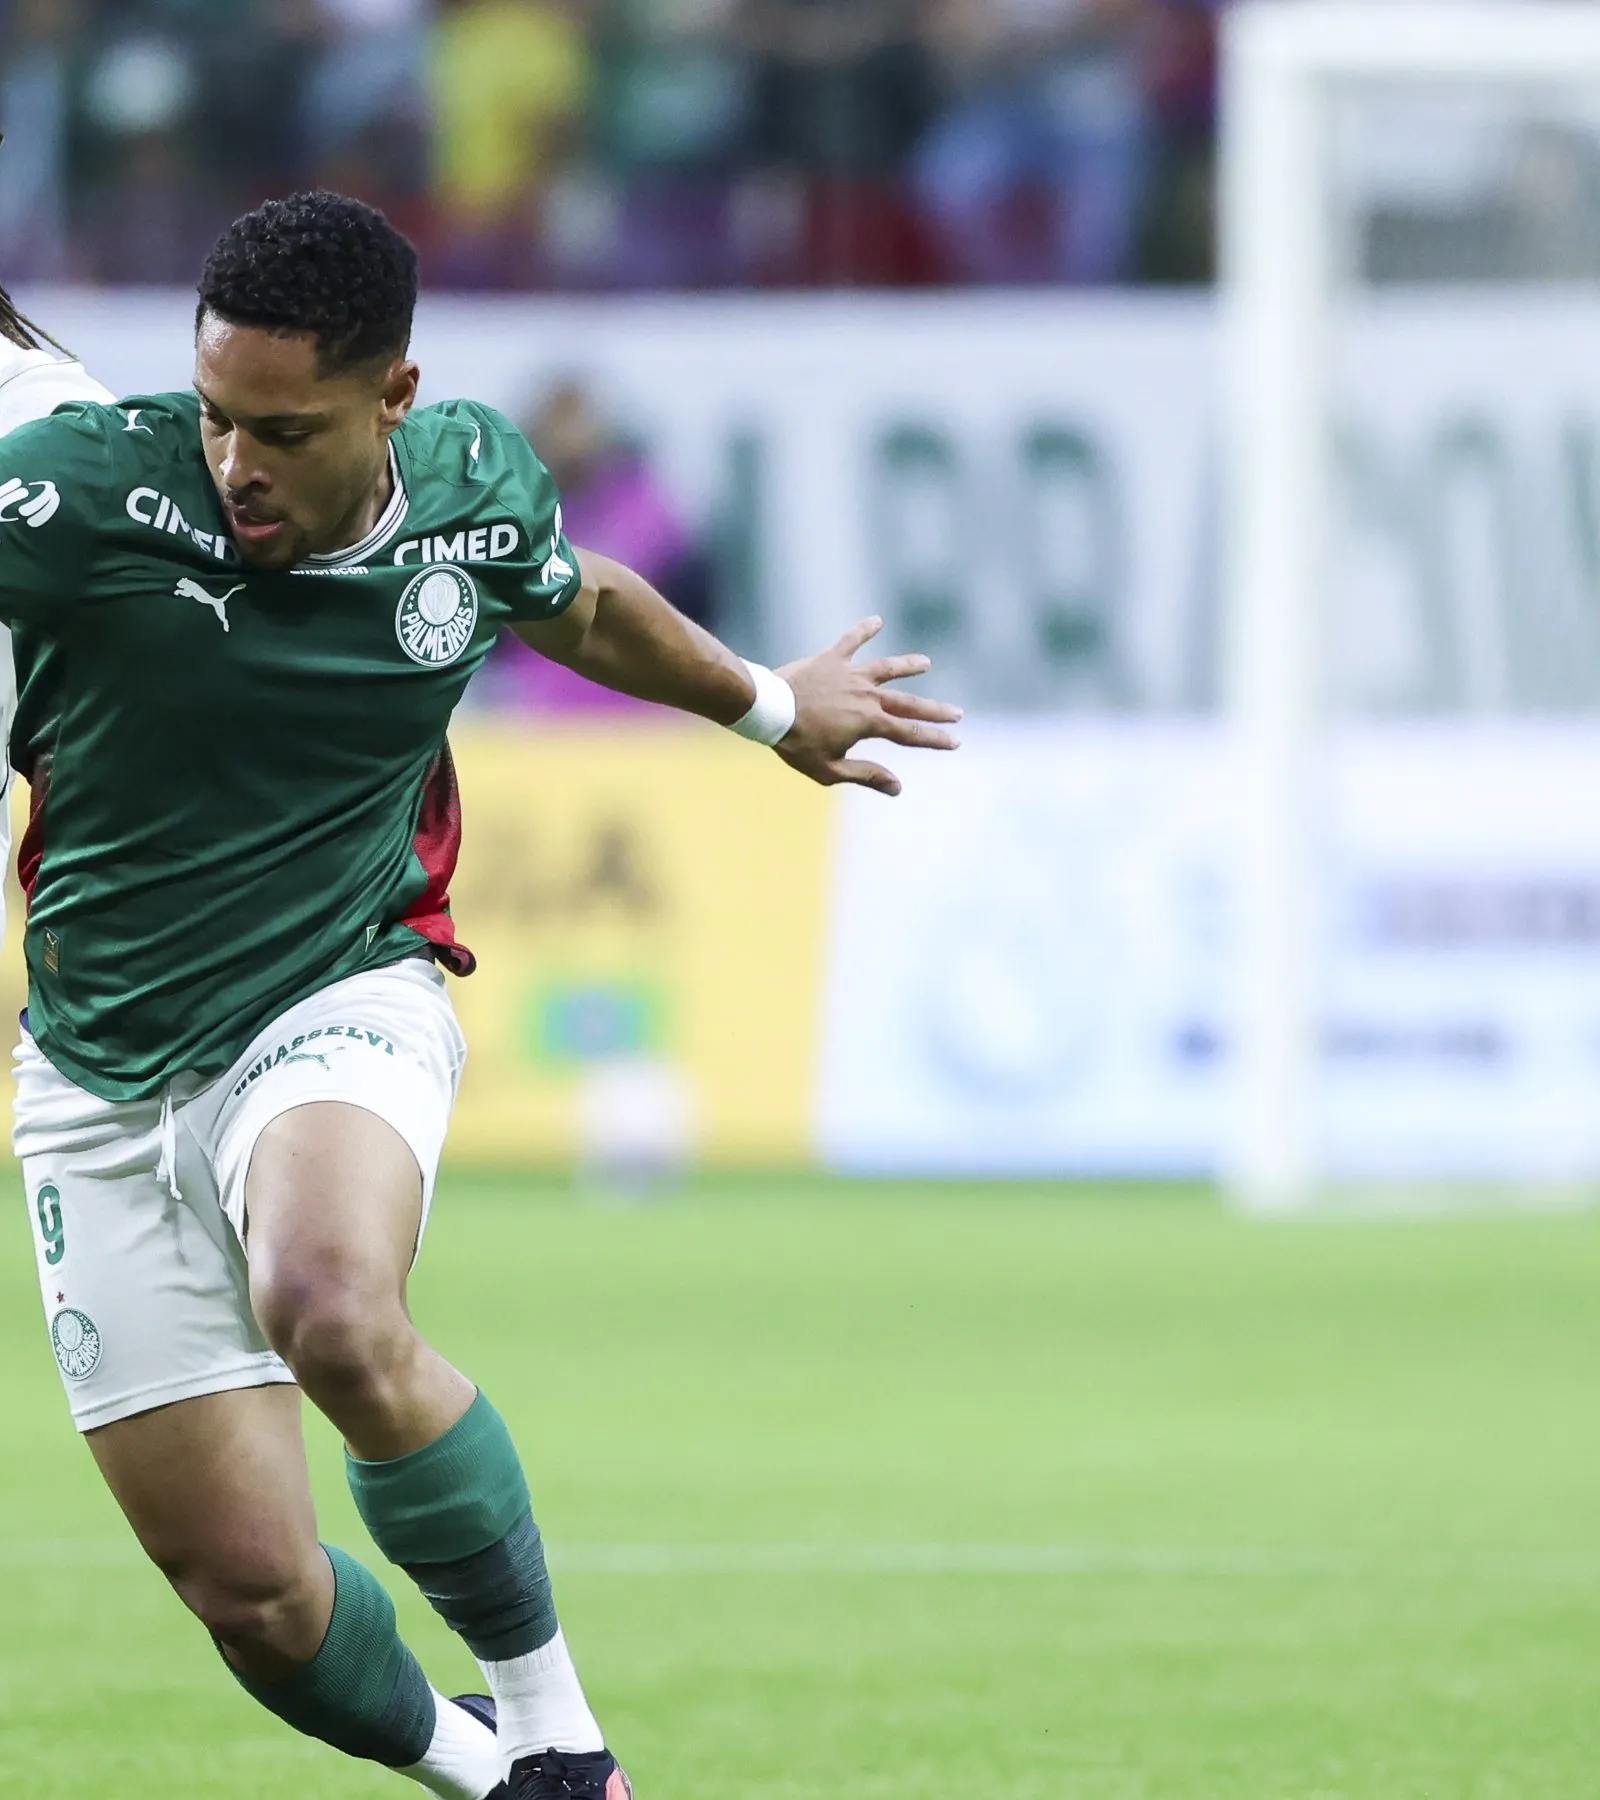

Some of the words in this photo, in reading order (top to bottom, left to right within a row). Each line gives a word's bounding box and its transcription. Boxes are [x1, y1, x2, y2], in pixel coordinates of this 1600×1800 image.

[393, 523, 520, 567] CIMED
[401, 605, 474, 661] PALMEIRAS
[36, 1183, 66, 1266] 9
